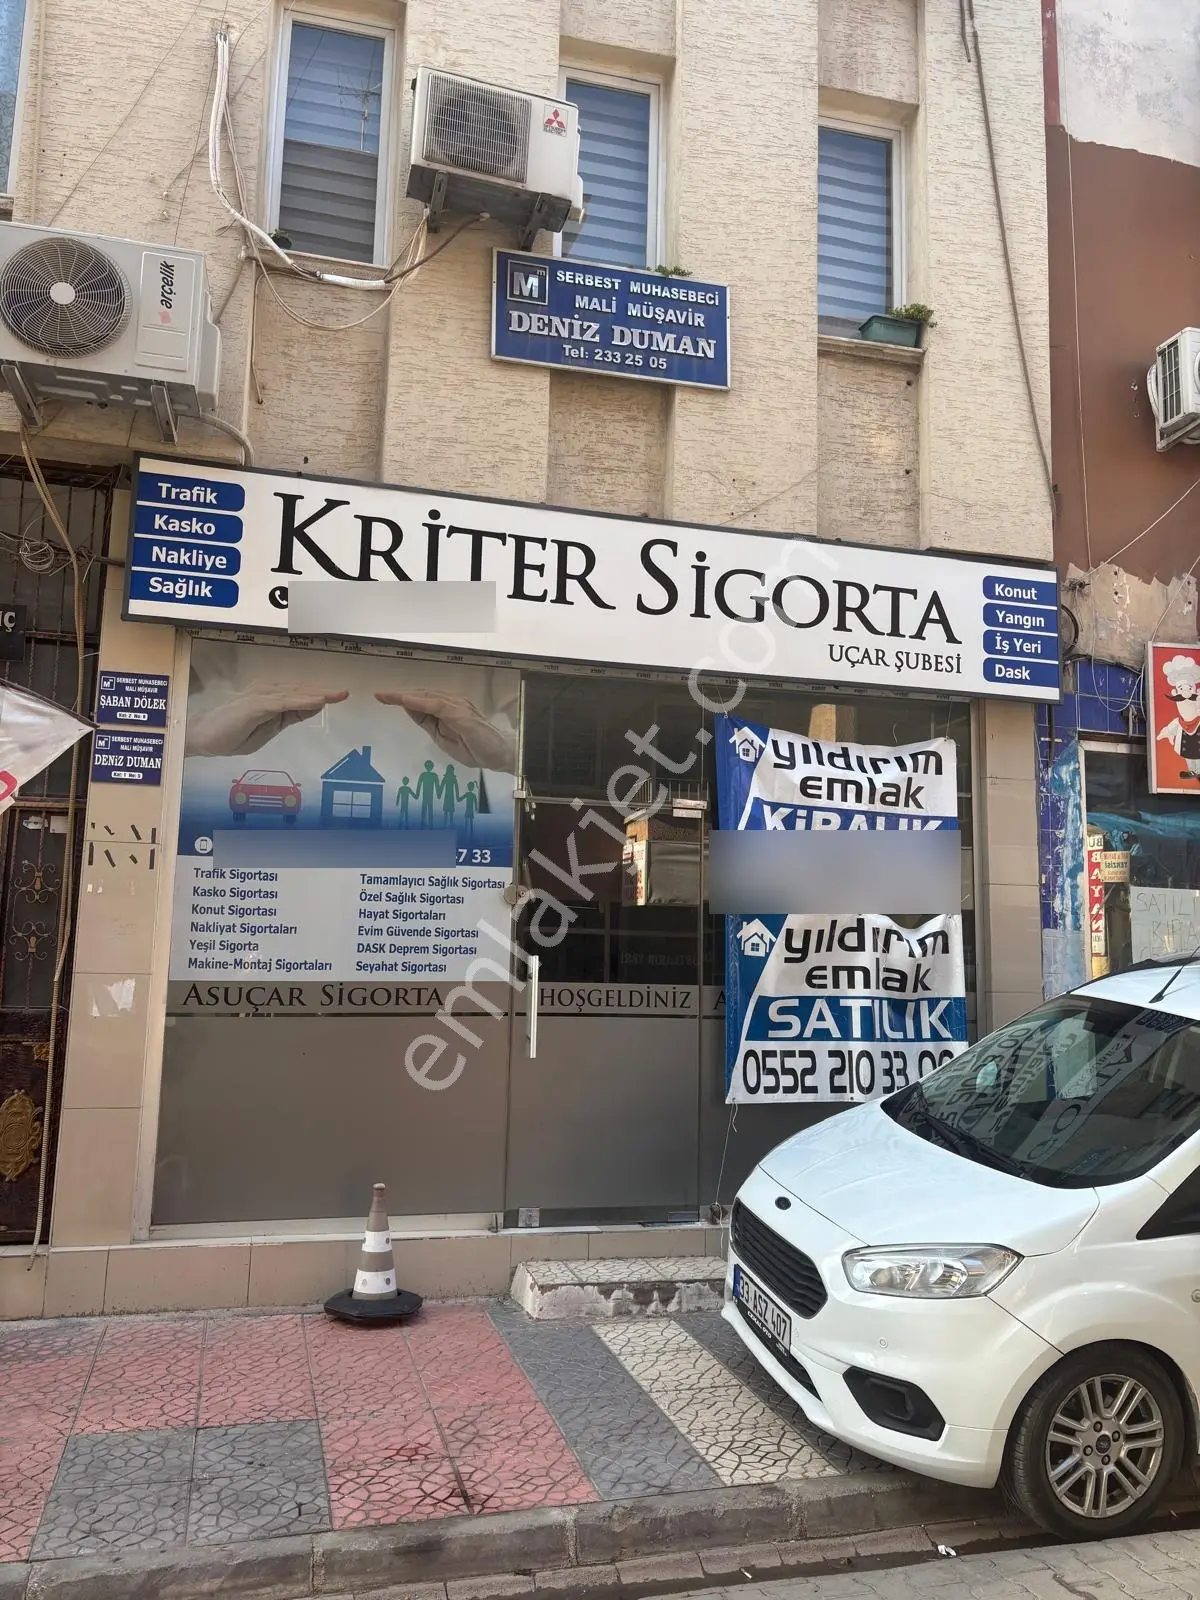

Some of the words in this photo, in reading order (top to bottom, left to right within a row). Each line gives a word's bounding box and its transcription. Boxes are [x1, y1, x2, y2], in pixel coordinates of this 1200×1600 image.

[159, 260, 176, 309] arçelik
[556, 270, 621, 290] SERBEST
[630, 280, 719, 306] MUHASEBECİ
[575, 295, 617, 313] MALİ
[627, 302, 705, 328] MÜŞAVİR
[509, 310, 600, 342] DENİZ
[611, 324, 716, 359] DUMAN
[563, 344, 589, 359] Tel:
[594, 348, 621, 364] 233
[625, 352, 643, 366] 25
[649, 356, 667, 370] 05
[158, 483, 217, 505] Trafik
[154, 514, 216, 536] Kasko
[151, 545, 227, 569] Nakliye
[270, 491, 616, 611] KRİTER
[636, 538, 963, 645] SİGORTA
[148, 576, 213, 600] Sağlık
[994, 583, 1038, 601] Konut
[995, 610, 1046, 631] Yangın
[994, 633, 1010, 654] İş
[1011, 636, 1042, 654] Yeri
[828, 643, 890, 668] UÇAR
[894, 649, 963, 676] ŞUBESİ
[994, 665, 1031, 681] Dask
[100, 695, 132, 709] ŞABAN
[133, 695, 167, 710] DÖLEK
[95, 754, 124, 767] DENİZ
[126, 756, 161, 769] DUMAN
[770, 738, 943, 776] yıldırım
[799, 776, 924, 810] emlak
[472, 849, 491, 864] 33
[194, 867, 227, 880] Trafik
[229, 868, 278, 883] Sigortası
[360, 873, 426, 889] Tamamlayıcı
[427, 874, 459, 889] Sağlık
[461, 877, 506, 891] Sigortası
[192, 886, 227, 898] Kasko
[229, 886, 278, 900] Sigortası
[359, 889, 383, 904] Özel
[385, 891, 416, 905] Sağlık
[418, 893, 465, 907] Sigortası
[191, 904, 226, 916] Konut
[228, 904, 277, 918] Sigortası
[358, 908, 390, 922] Hayat
[393, 909, 446, 922] Sigortaları
[190, 922, 237, 936] Nakliyat
[239, 923, 298, 937] Sigortaları
[357, 925, 384, 938] Evim
[386, 925, 432, 939] Güvende
[434, 927, 479, 940] Sigortası
[189, 939, 216, 953] Yeşil
[218, 940, 259, 954] Sigorta
[356, 943, 386, 955] DASK
[388, 943, 430, 957] Deprem
[431, 944, 477, 958] Sigortası
[783, 918, 950, 964] yıldırım
[187, 958, 272, 973] Makine-Montaj
[275, 959, 333, 974] Sigortaları
[355, 961, 398, 975] Seyahat
[401, 961, 448, 975] Sigortası
[805, 960, 932, 994] emlak
[182, 982, 307, 1012] ASUÇAR
[320, 981, 445, 1007] SİGORTA
[540, 985, 692, 1013] HOŞGELDİNİZ
[767, 998, 953, 1041] SATILIK
[742, 1049, 818, 1096] 0552
[828, 1049, 875, 1095] 210
[882, 1050, 908, 1094] 33
[740, 1275, 749, 1303] 33
[771, 1307, 787, 1341] 407
